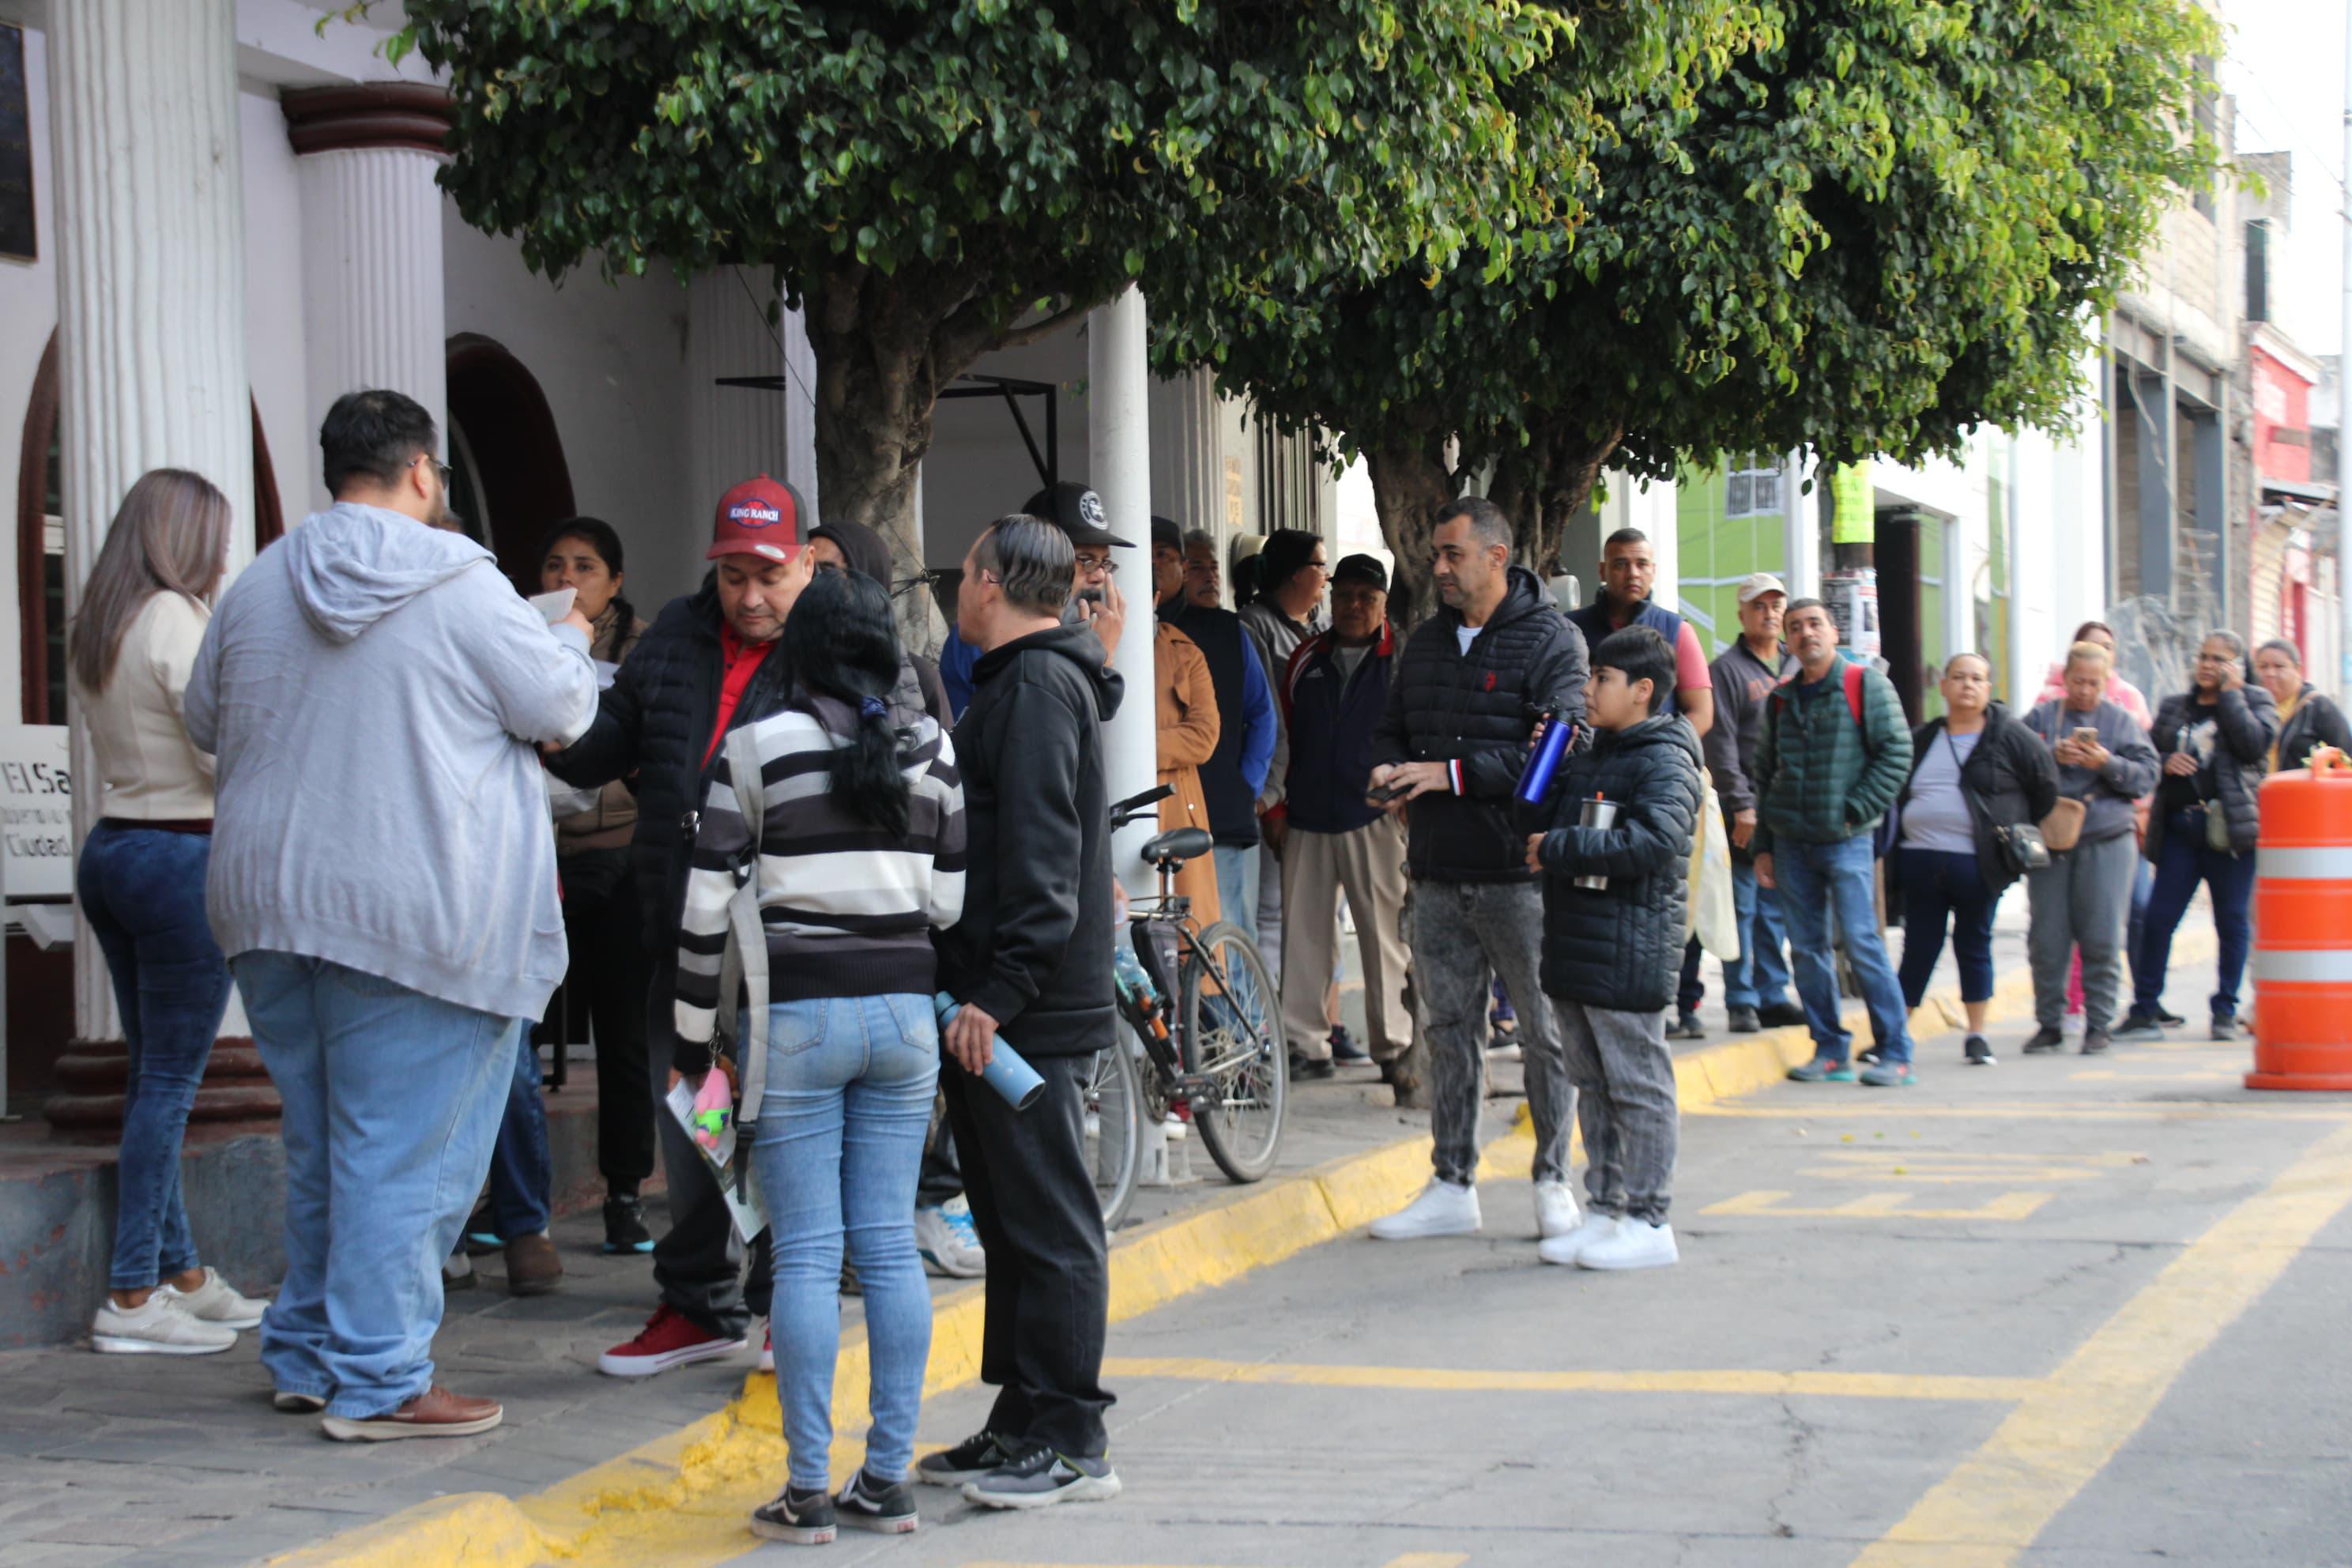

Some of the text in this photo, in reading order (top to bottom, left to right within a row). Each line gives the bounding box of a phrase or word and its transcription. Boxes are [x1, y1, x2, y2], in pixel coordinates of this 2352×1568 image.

[730, 507, 779, 522] KING RANCH
[6, 834, 72, 857] Ciudad
